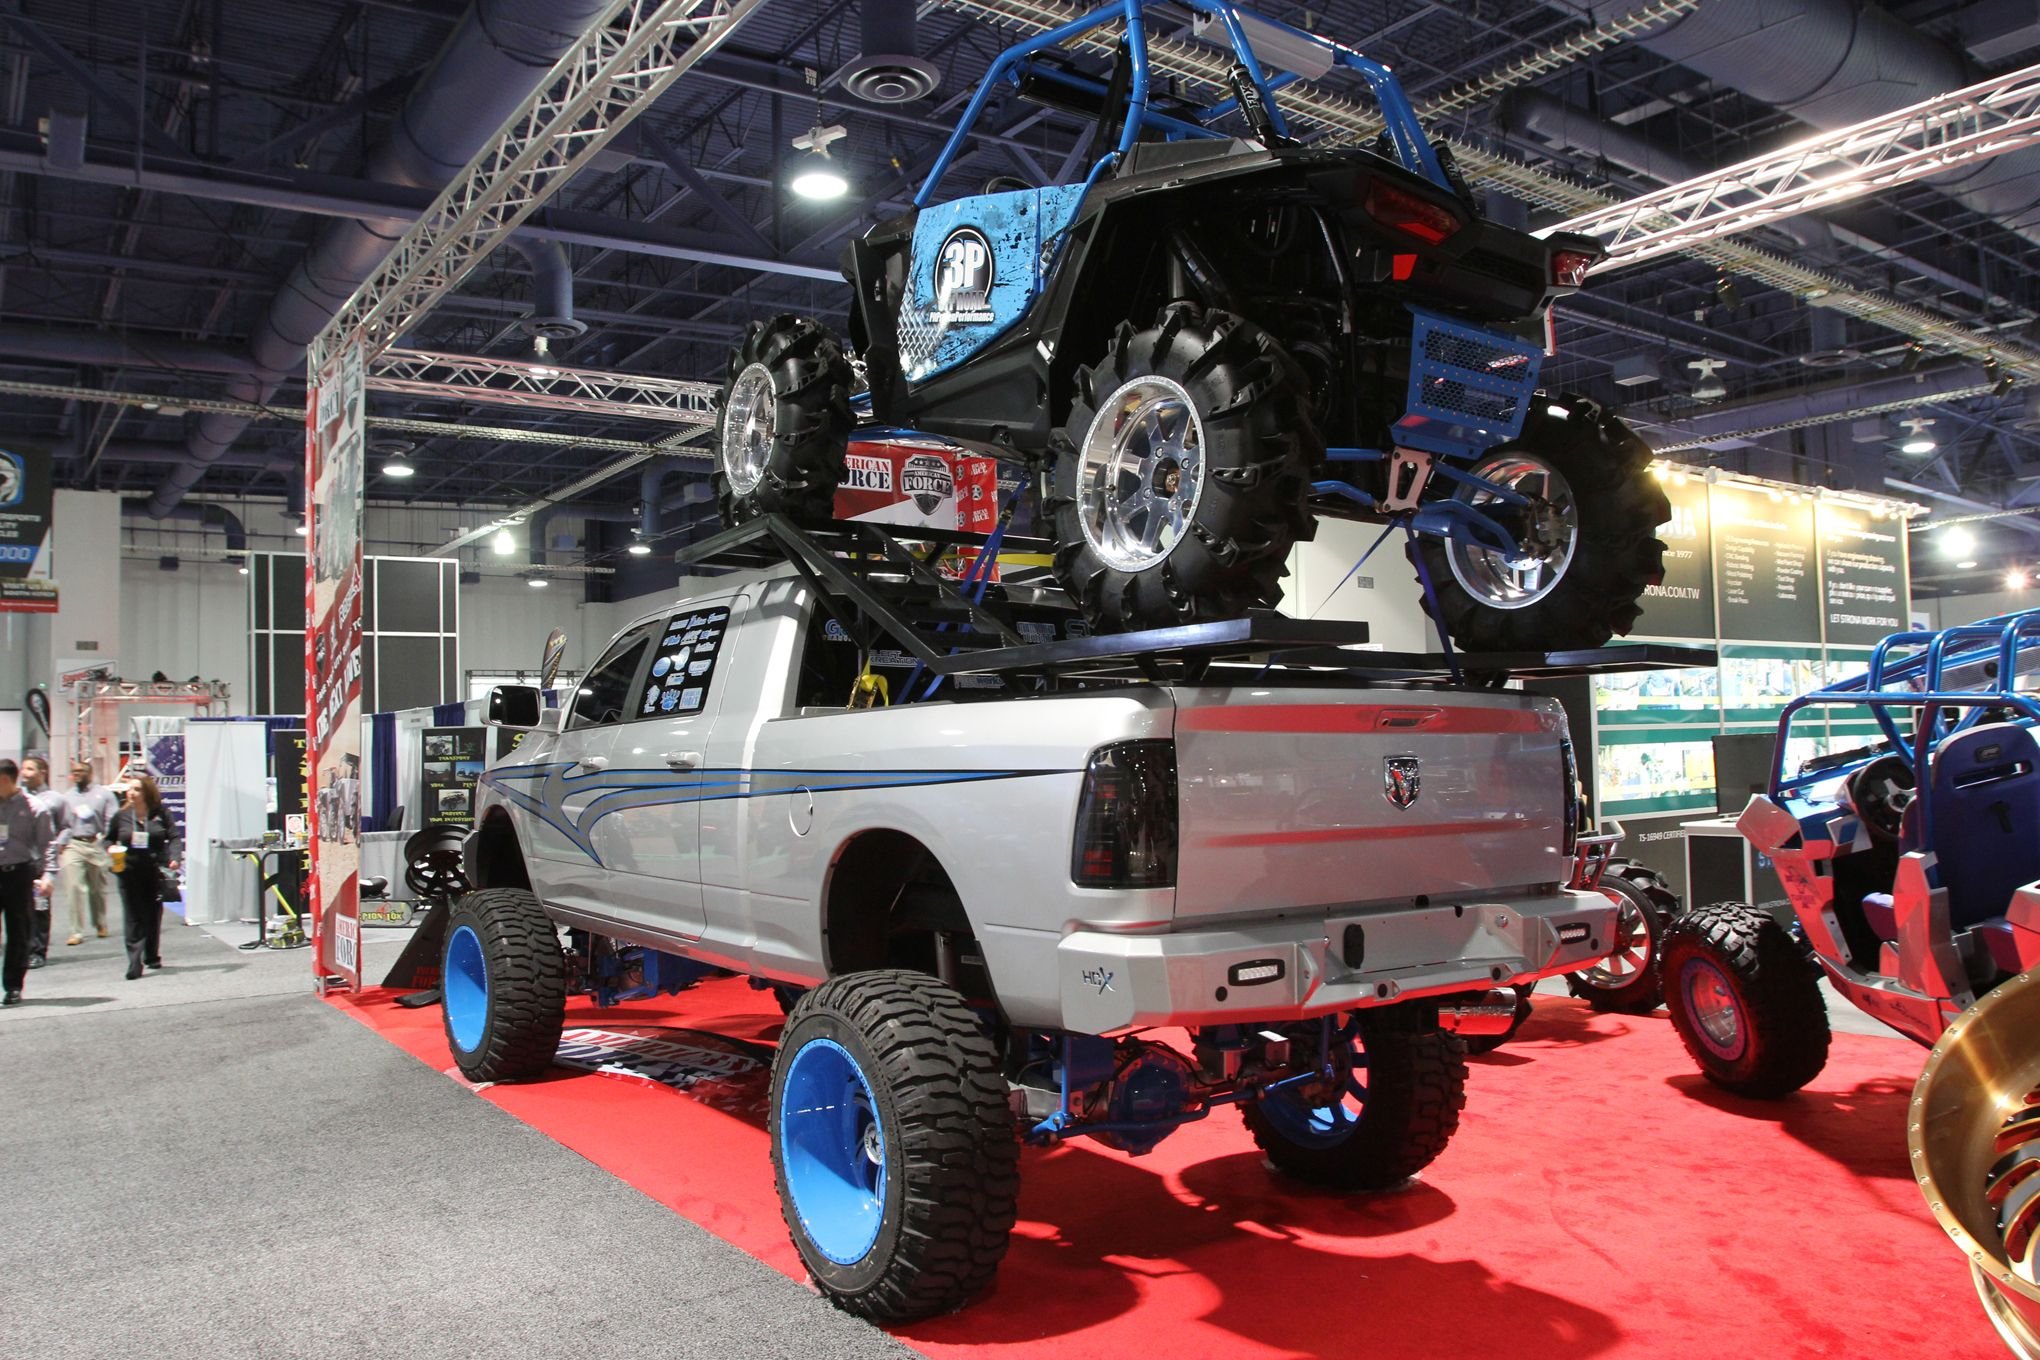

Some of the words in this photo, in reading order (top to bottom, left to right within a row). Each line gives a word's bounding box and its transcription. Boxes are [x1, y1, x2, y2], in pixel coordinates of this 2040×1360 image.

[943, 240, 985, 289] 3P
[845, 458, 889, 472] ERICAN
[839, 470, 890, 489] RCE
[904, 475, 952, 491] FORCE
[1676, 550, 1693, 559] 1977
[1663, 829, 1687, 840] CERTIFIE
[360, 911, 384, 921] PION
